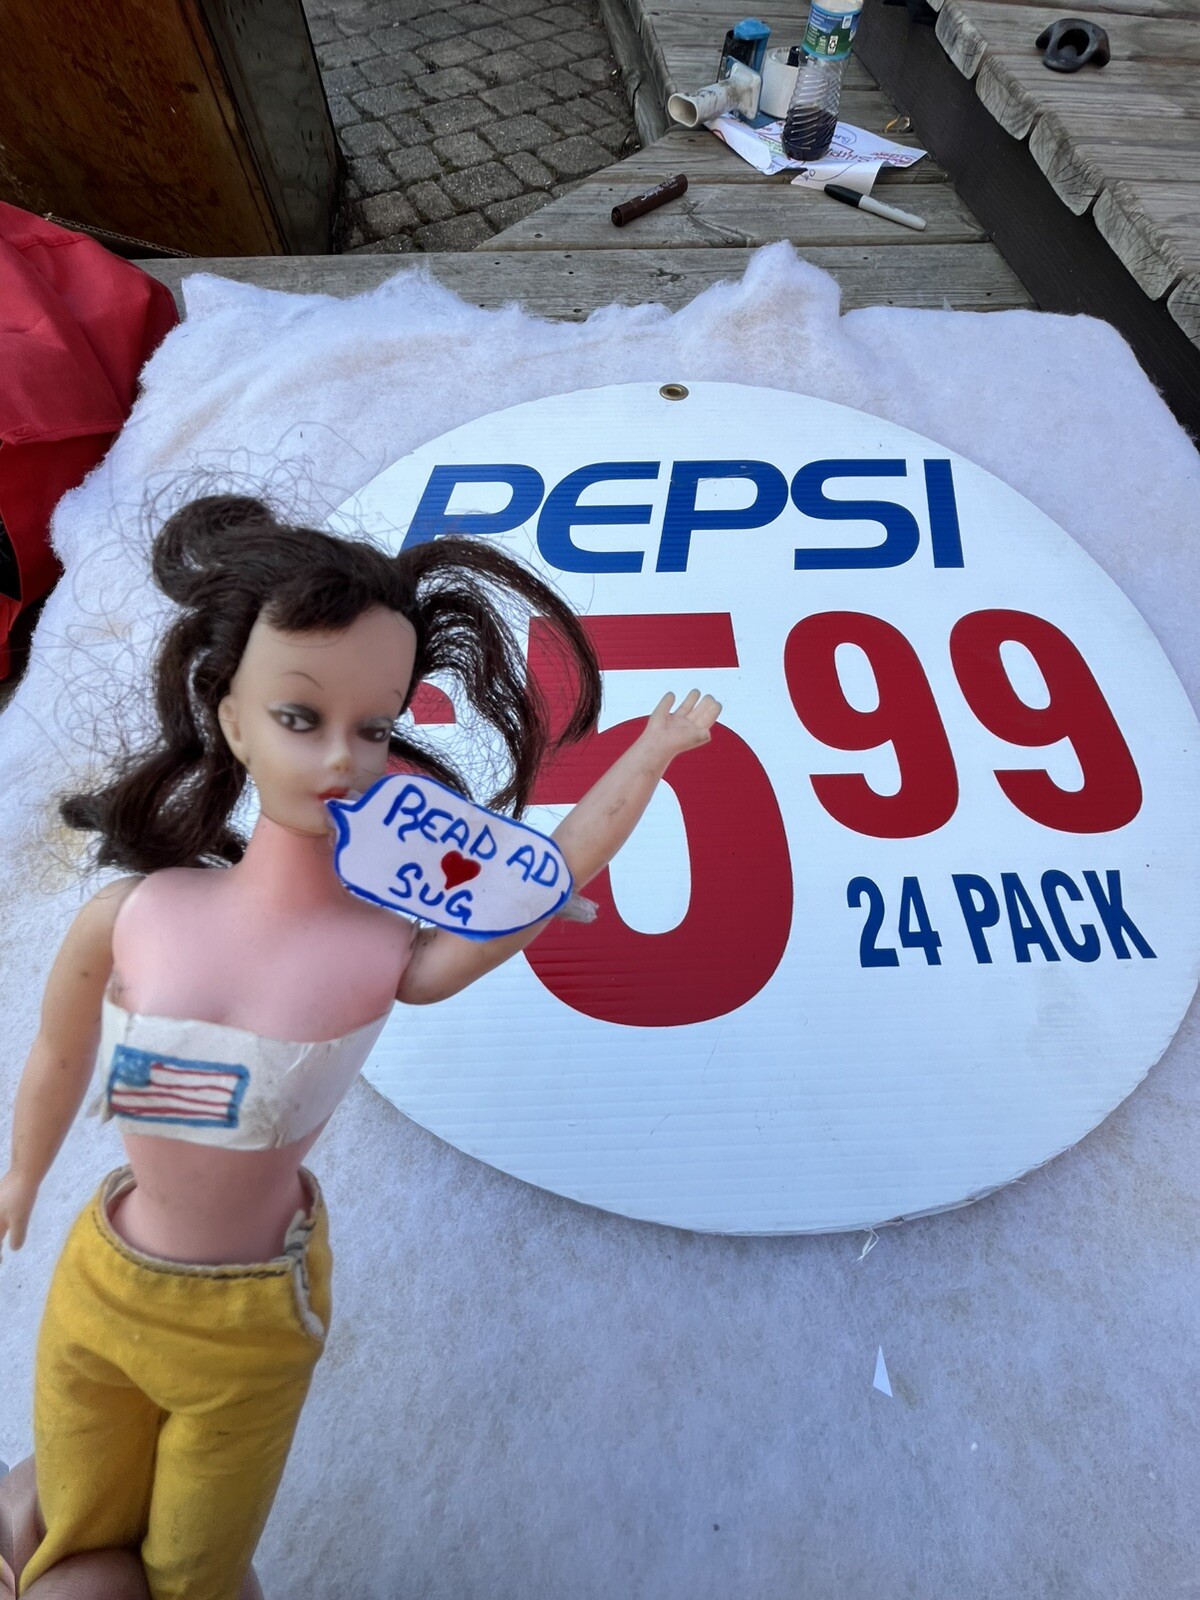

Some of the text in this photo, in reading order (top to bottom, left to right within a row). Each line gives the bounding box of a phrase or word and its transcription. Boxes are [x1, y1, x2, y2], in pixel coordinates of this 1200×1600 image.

[400, 459, 964, 574] PEPSI
[383, 783, 560, 888] READ AD
[388, 862, 474, 926] SUG
[847, 869, 1158, 968] 24 PACK
